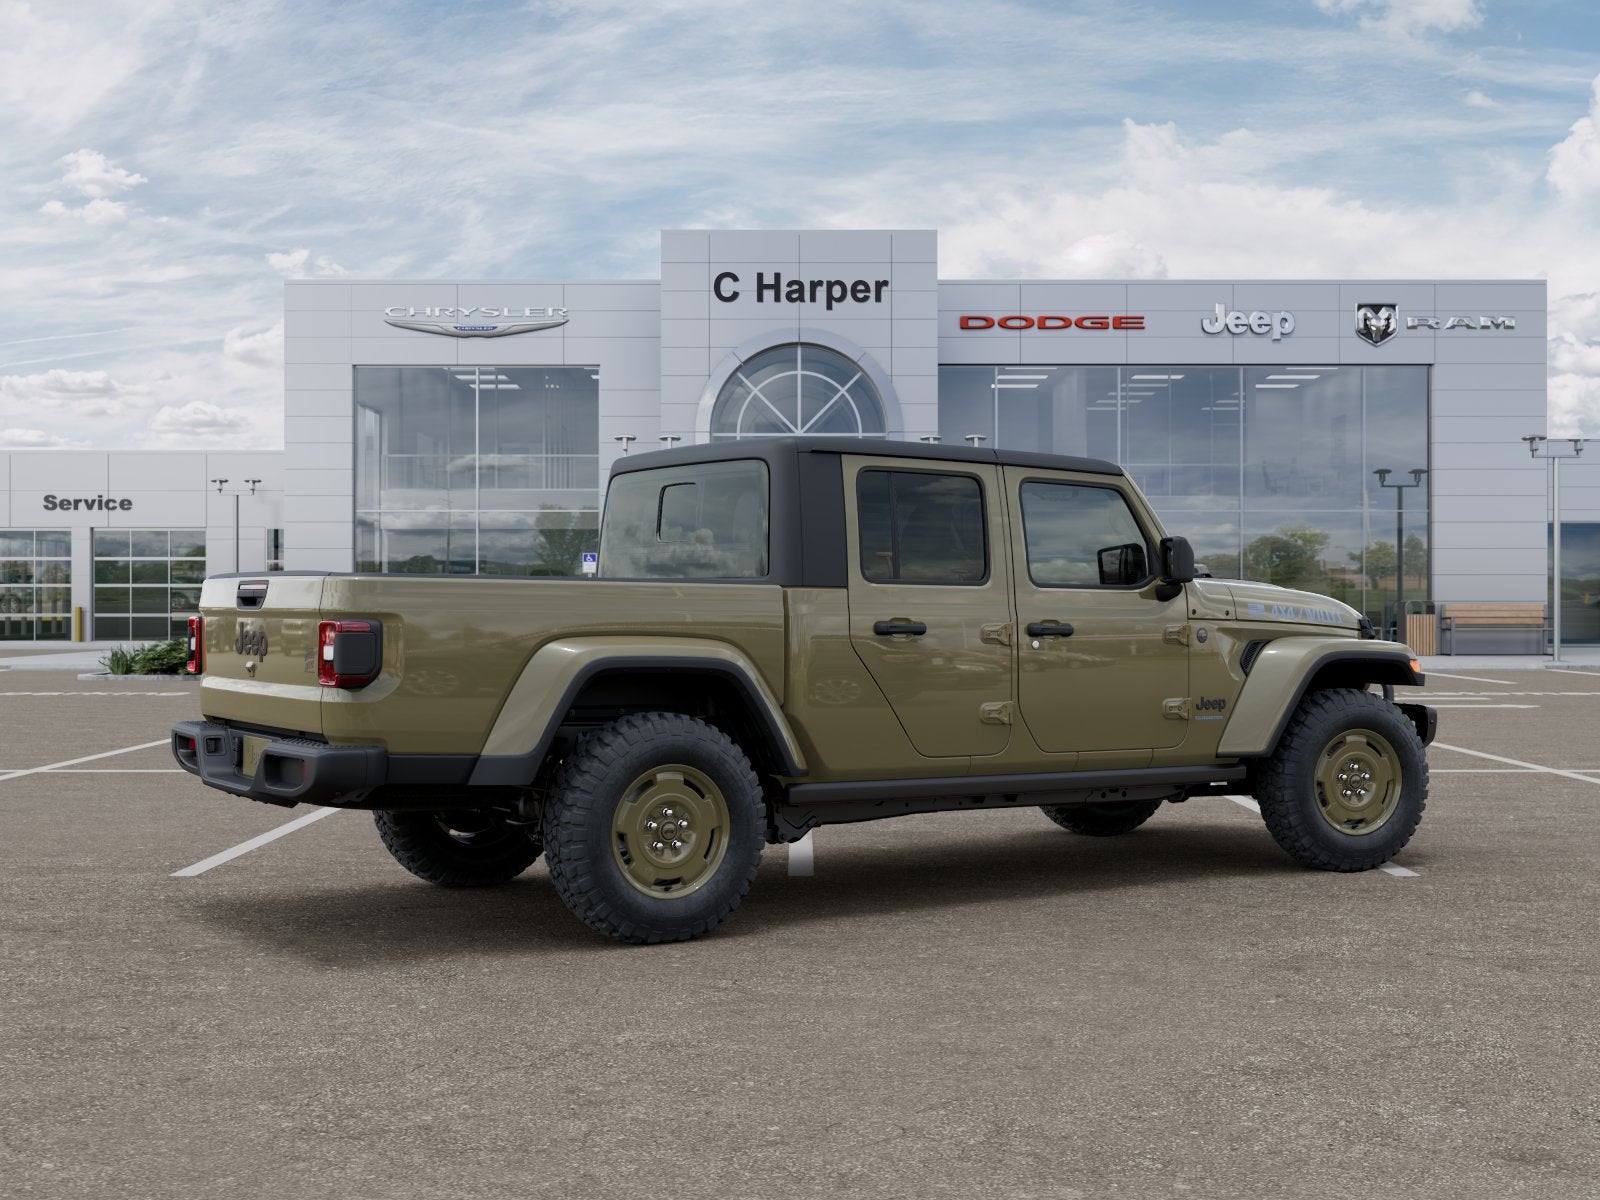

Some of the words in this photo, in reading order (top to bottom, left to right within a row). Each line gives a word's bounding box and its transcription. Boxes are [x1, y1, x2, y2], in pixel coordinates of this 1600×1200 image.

[713, 271, 740, 303] C
[756, 272, 889, 311] Harper
[384, 305, 569, 317] CHRYSLER
[959, 315, 1146, 330] DODGE
[1200, 303, 1296, 341] Jeep
[1406, 315, 1516, 330] RAM
[43, 494, 133, 511] Service
[235, 622, 268, 662] Jeep
[1196, 696, 1226, 712] Jeep
